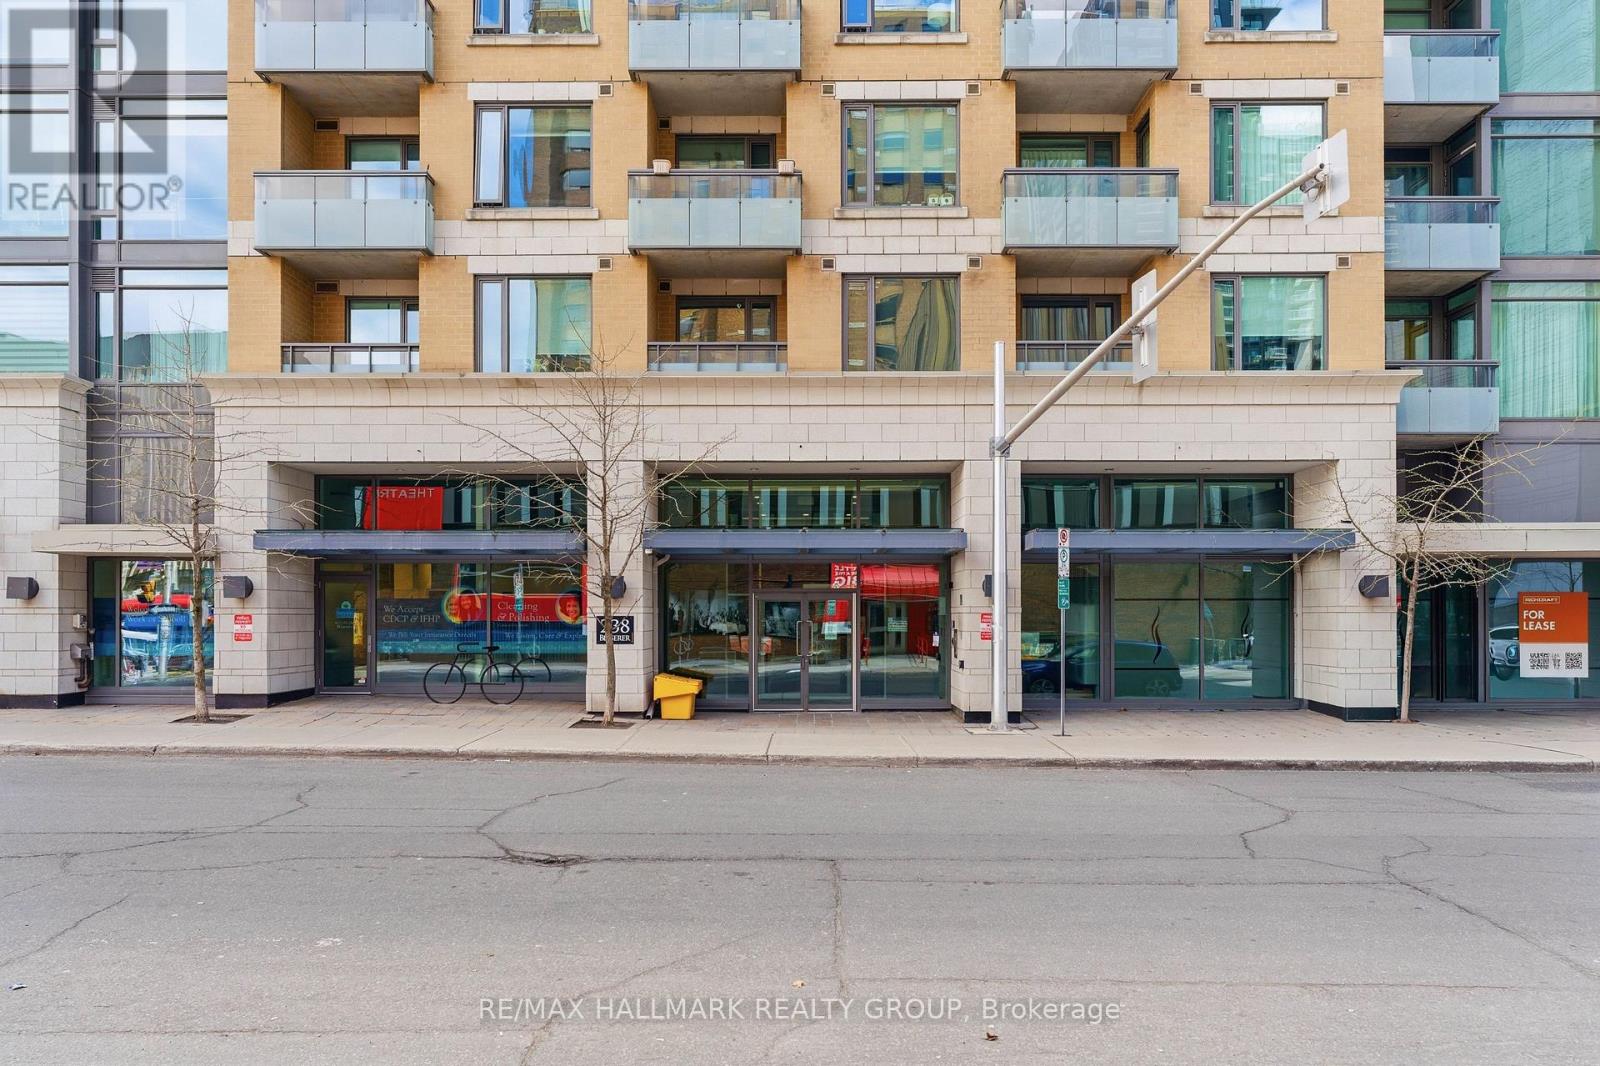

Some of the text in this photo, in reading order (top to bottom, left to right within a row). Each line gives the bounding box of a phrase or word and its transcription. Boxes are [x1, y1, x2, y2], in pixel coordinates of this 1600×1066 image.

[383, 605, 396, 613] We
[497, 602, 538, 611] Cleing
[509, 612, 550, 624] Polishing
[1523, 610, 1545, 620] FOR
[1523, 621, 1556, 631] LEASE
